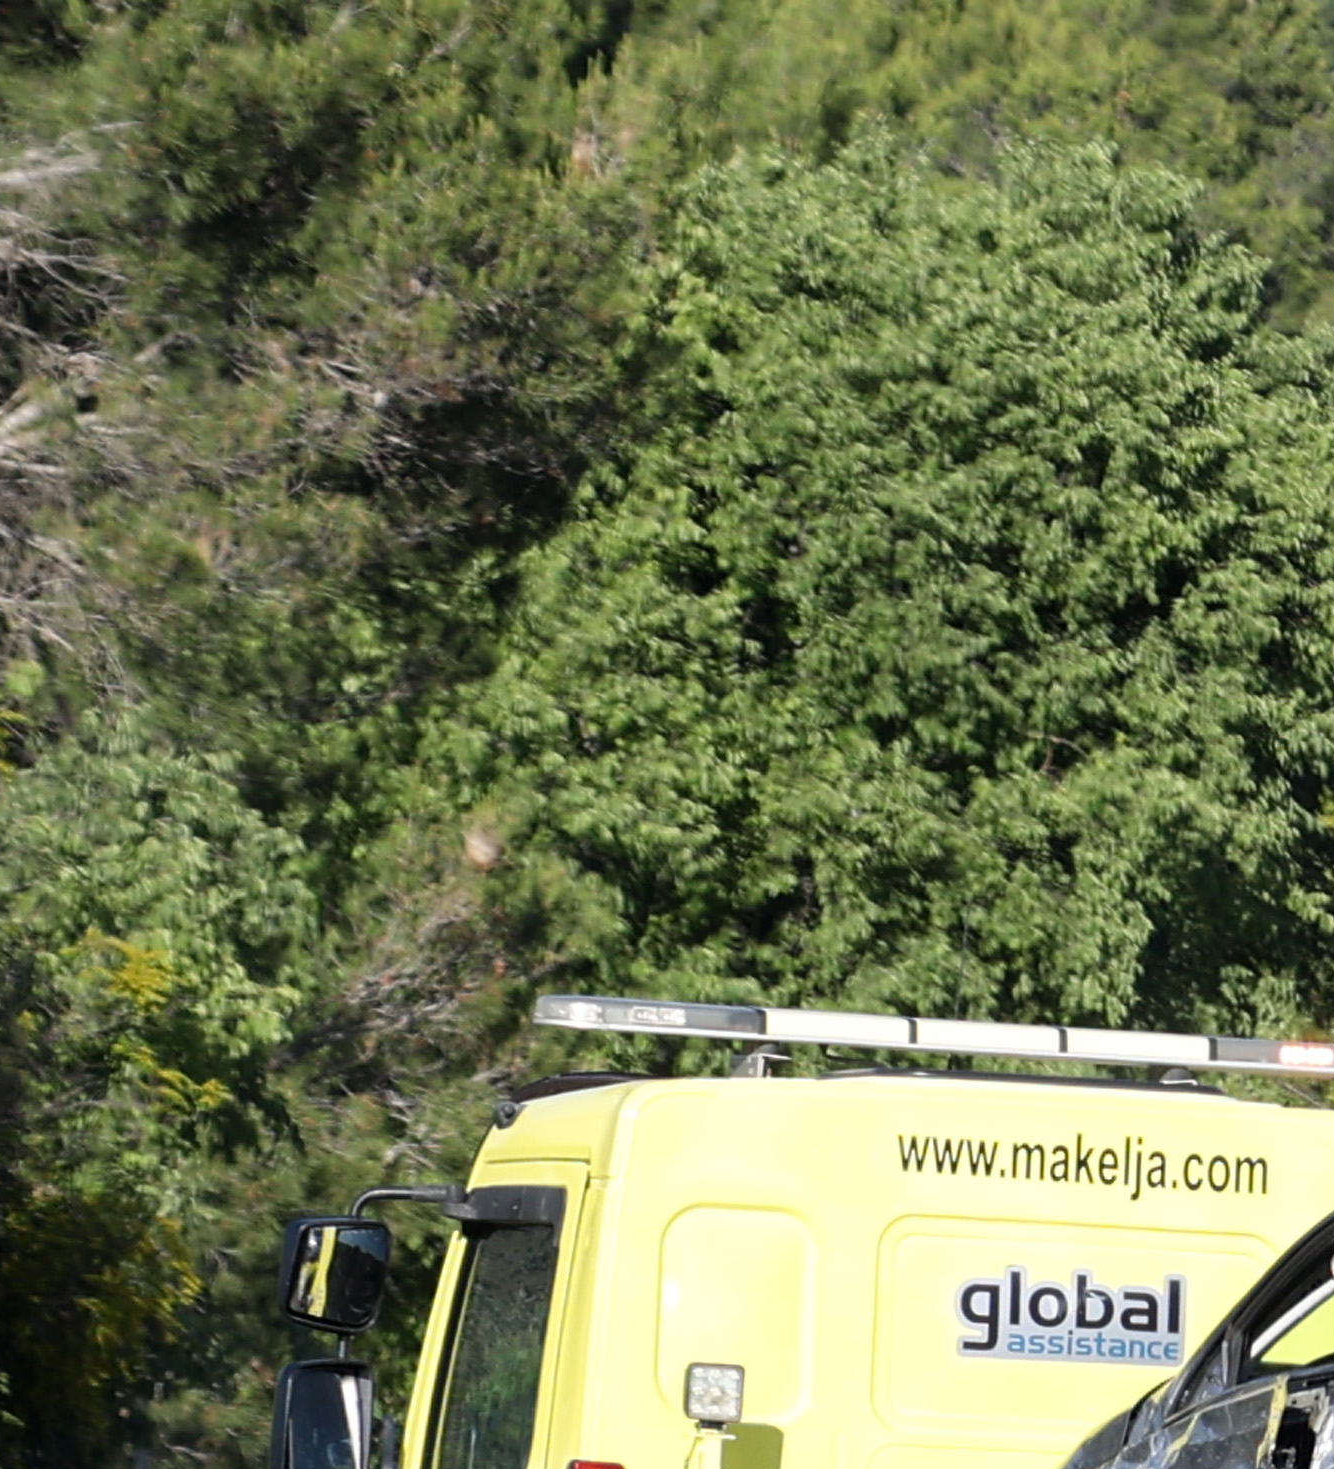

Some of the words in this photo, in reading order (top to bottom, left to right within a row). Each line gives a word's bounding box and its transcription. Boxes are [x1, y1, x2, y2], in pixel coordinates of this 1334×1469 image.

[898, 1133, 1268, 1200] www.makelja.com
[959, 1271, 1181, 1351] global
[1007, 1330, 1180, 1361] assistance
